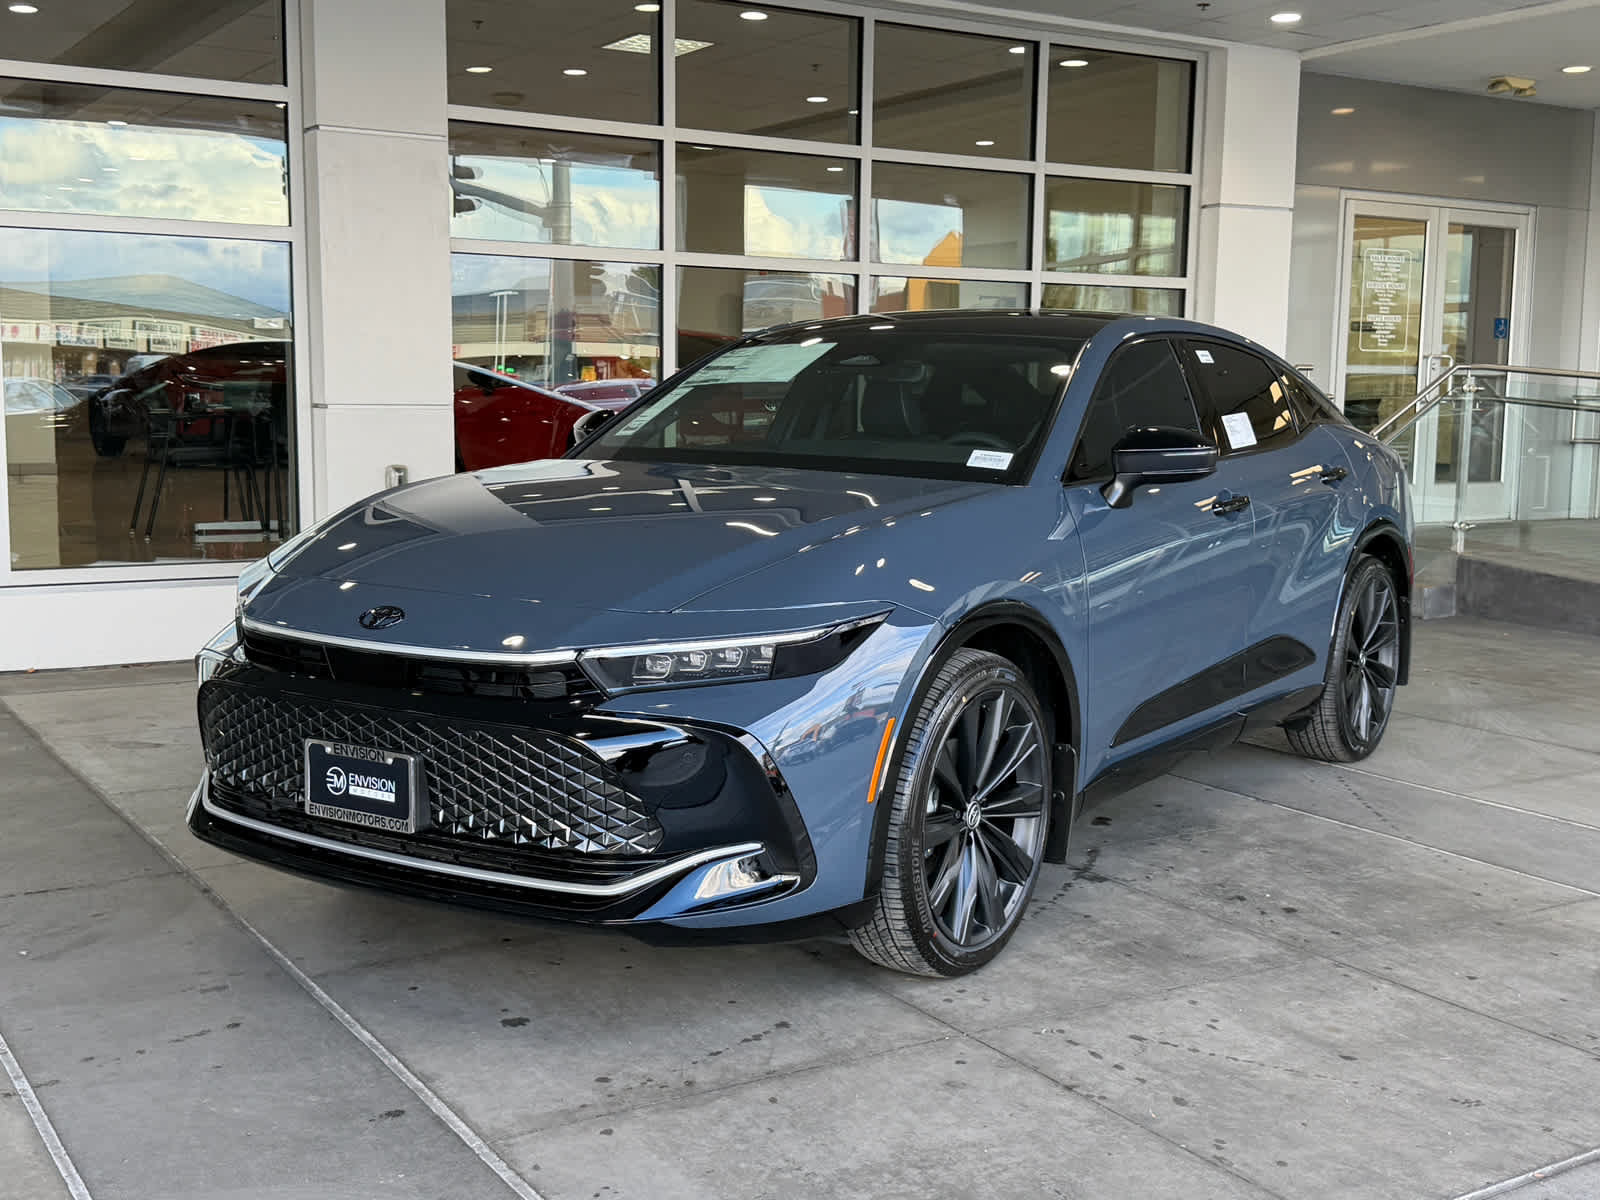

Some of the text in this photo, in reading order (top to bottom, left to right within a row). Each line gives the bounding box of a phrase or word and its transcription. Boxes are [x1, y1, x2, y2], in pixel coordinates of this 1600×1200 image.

[333, 743, 385, 762] ENVISION
[348, 772, 396, 793] ENVISION
[309, 803, 409, 832] ENVISIONMOTORS.COM
